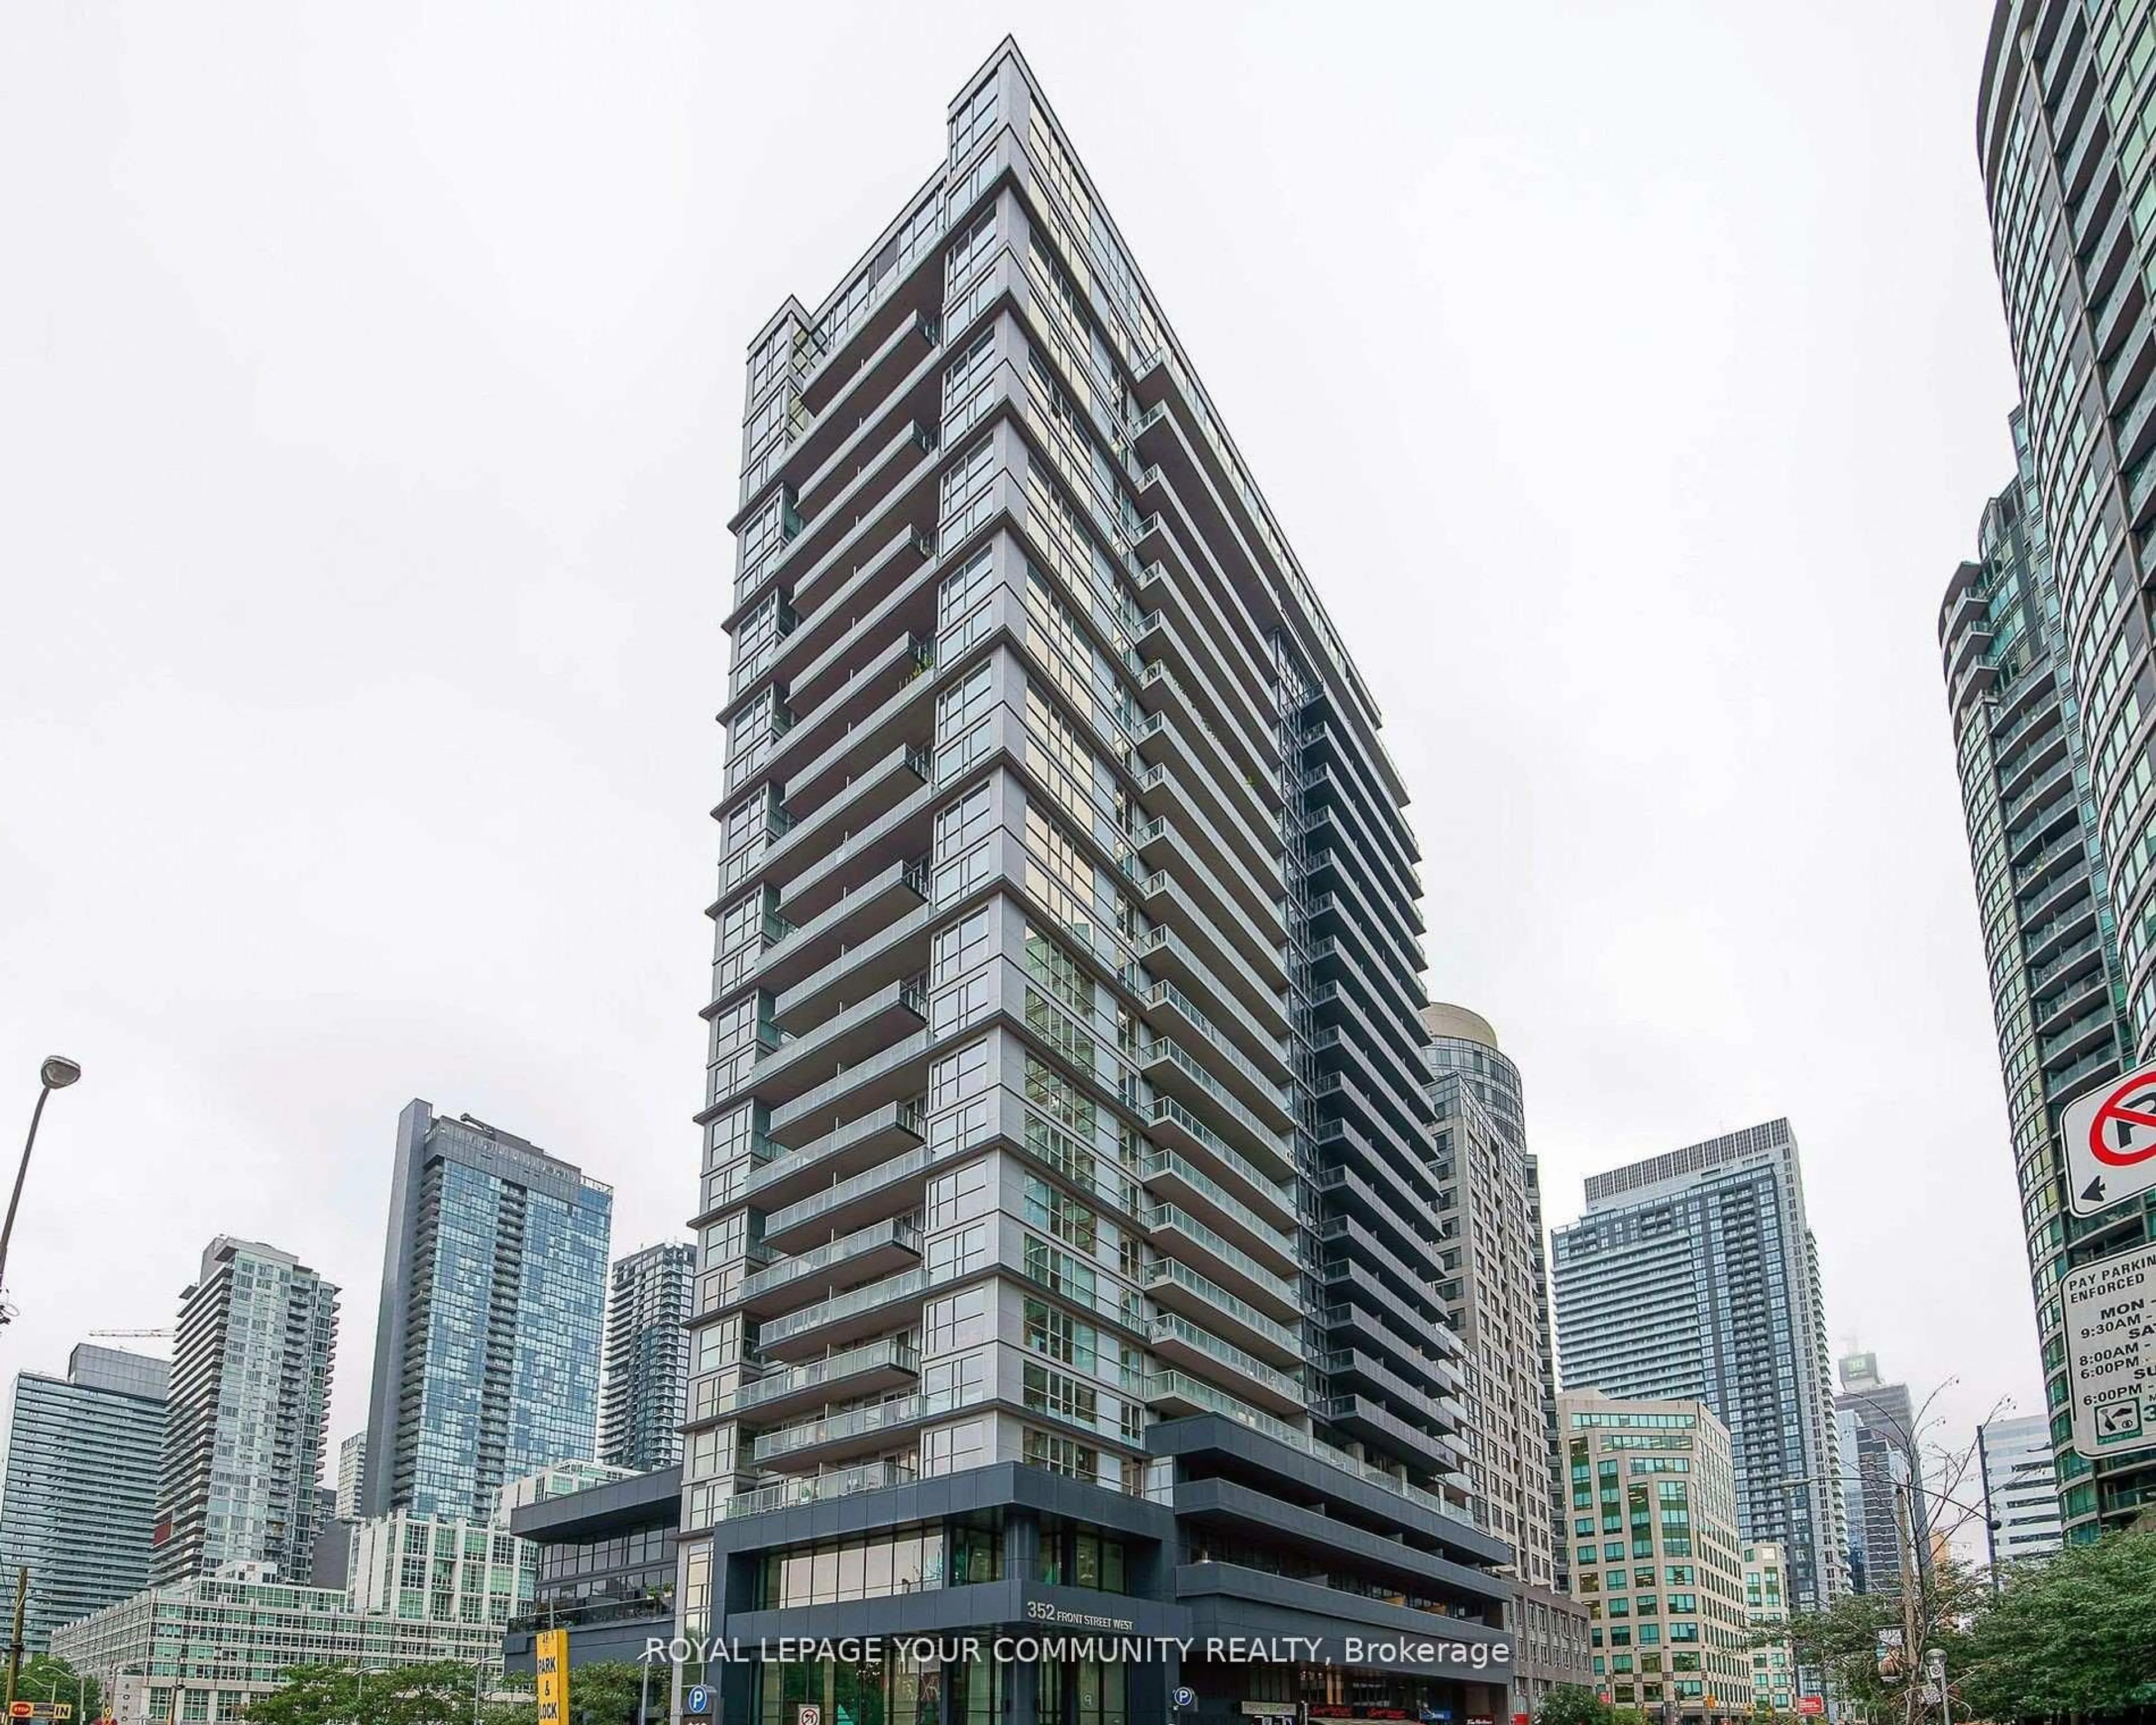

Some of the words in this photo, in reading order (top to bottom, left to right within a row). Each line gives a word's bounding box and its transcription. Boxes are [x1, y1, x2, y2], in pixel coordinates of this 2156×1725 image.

[2070, 1274, 2095, 1290] PAY
[2071, 1274, 2144, 1303] ENFORCED
[2100, 1299, 2144, 1320] MON
[2081, 1313, 2141, 1339] 9:30AM
[2128, 1323, 2156, 1339] SA
[2080, 1342, 2139, 1366] 8:00AM
[2081, 1356, 2139, 1379] 6:00PM
[2084, 1384, 2142, 1405] 6:00PM
[1027, 1601, 1056, 1621] 352
[1057, 1611, 1082, 1624] FRONT
[1084, 1615, 1112, 1628] STREET
[1113, 1619, 1133, 1630] WEST
[538, 1656, 556, 1675] PARK
[545, 1680, 550, 1696] &
[56, 1706, 69, 1717] IN
[539, 1702, 558, 1720] LOCK
